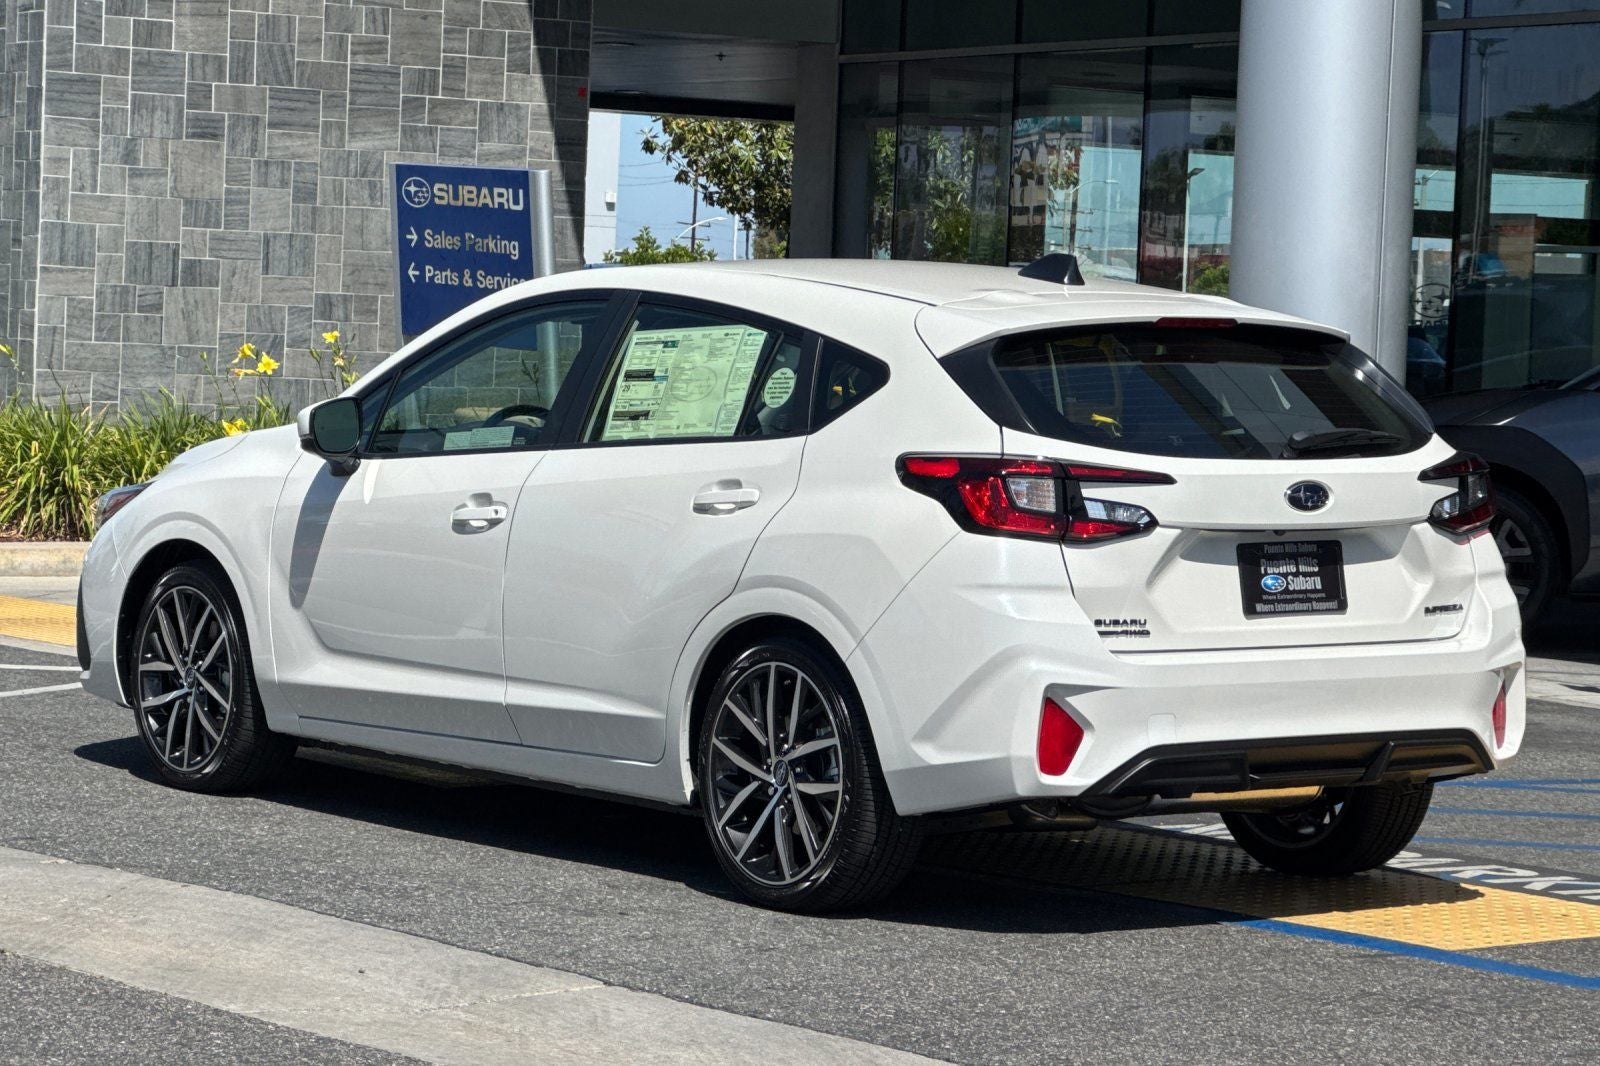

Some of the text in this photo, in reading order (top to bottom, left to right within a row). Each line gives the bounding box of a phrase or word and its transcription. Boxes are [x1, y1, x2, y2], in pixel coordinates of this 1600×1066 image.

[433, 183, 524, 211] SUBARU
[424, 229, 520, 260] Sales Parking
[425, 265, 459, 286] Parts
[463, 269, 473, 287] &
[1260, 557, 1319, 574] Puente Hills
[1287, 575, 1322, 591] Subaru
[1255, 603, 1274, 612] Where
[1094, 619, 1147, 627] SUBARU
